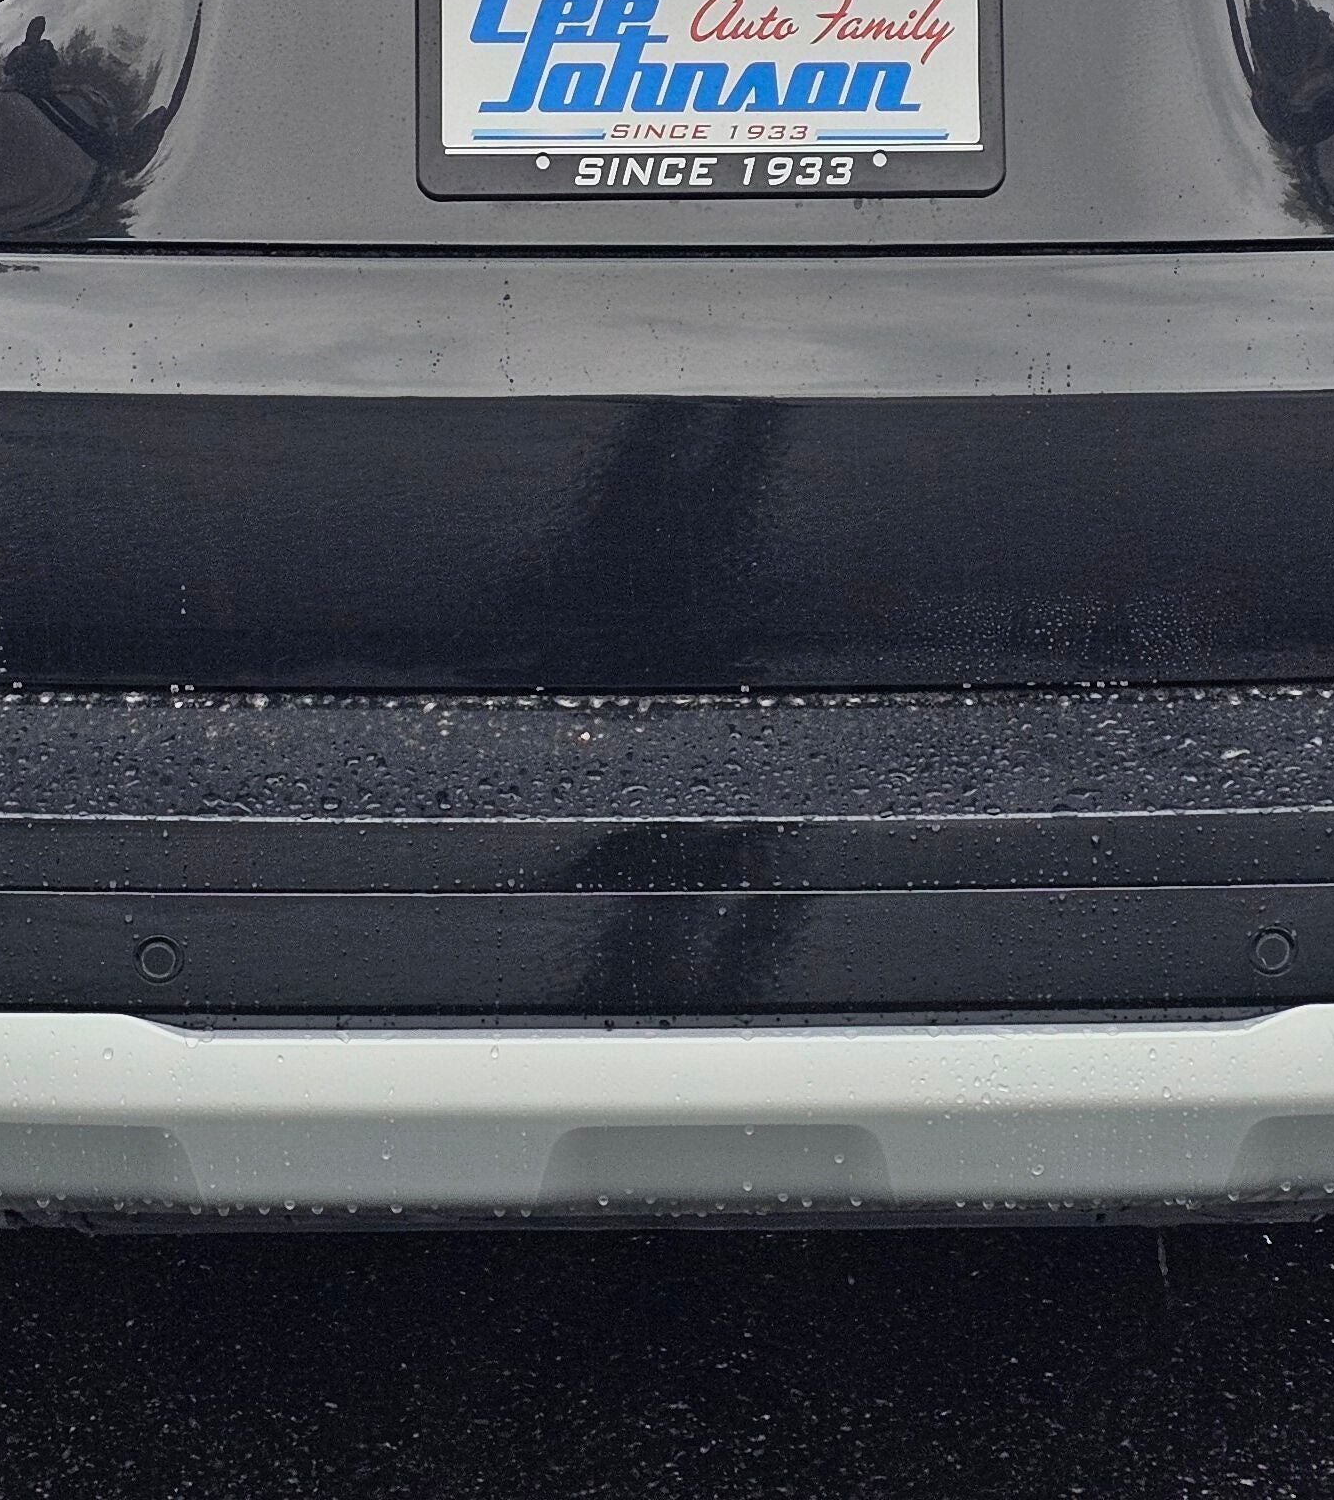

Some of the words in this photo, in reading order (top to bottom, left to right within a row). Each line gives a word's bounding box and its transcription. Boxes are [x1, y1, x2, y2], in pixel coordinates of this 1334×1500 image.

[477, 33, 922, 113] Johnson
[610, 123, 712, 140] SINCE
[729, 124, 809, 140] 1933
[574, 156, 718, 186] SINCE
[742, 155, 854, 186] 1933
